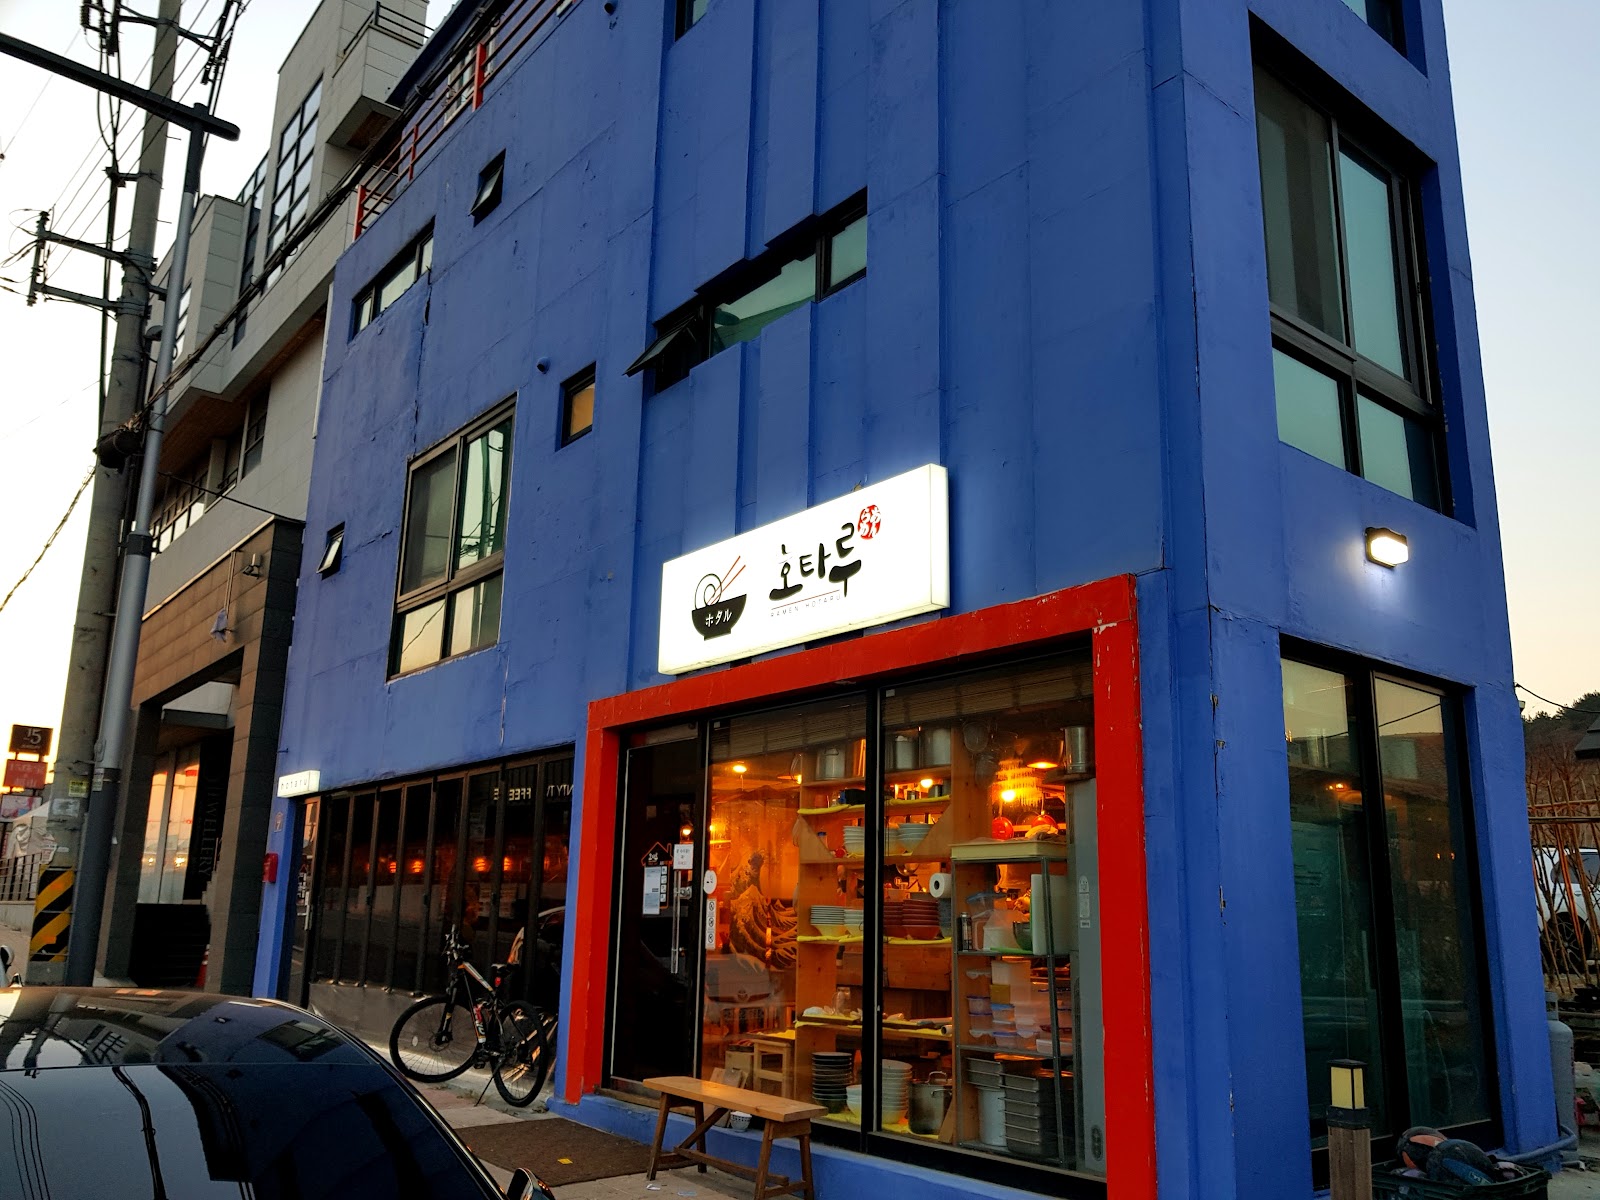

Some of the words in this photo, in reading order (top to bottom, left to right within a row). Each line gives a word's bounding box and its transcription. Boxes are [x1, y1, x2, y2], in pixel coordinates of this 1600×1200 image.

[769, 522, 862, 601] 호타루
[770, 606, 799, 617] RAMEN
[806, 594, 841, 608] HOTARU
[705, 609, 733, 627] ホタル
[281, 778, 308, 791] hotaru
